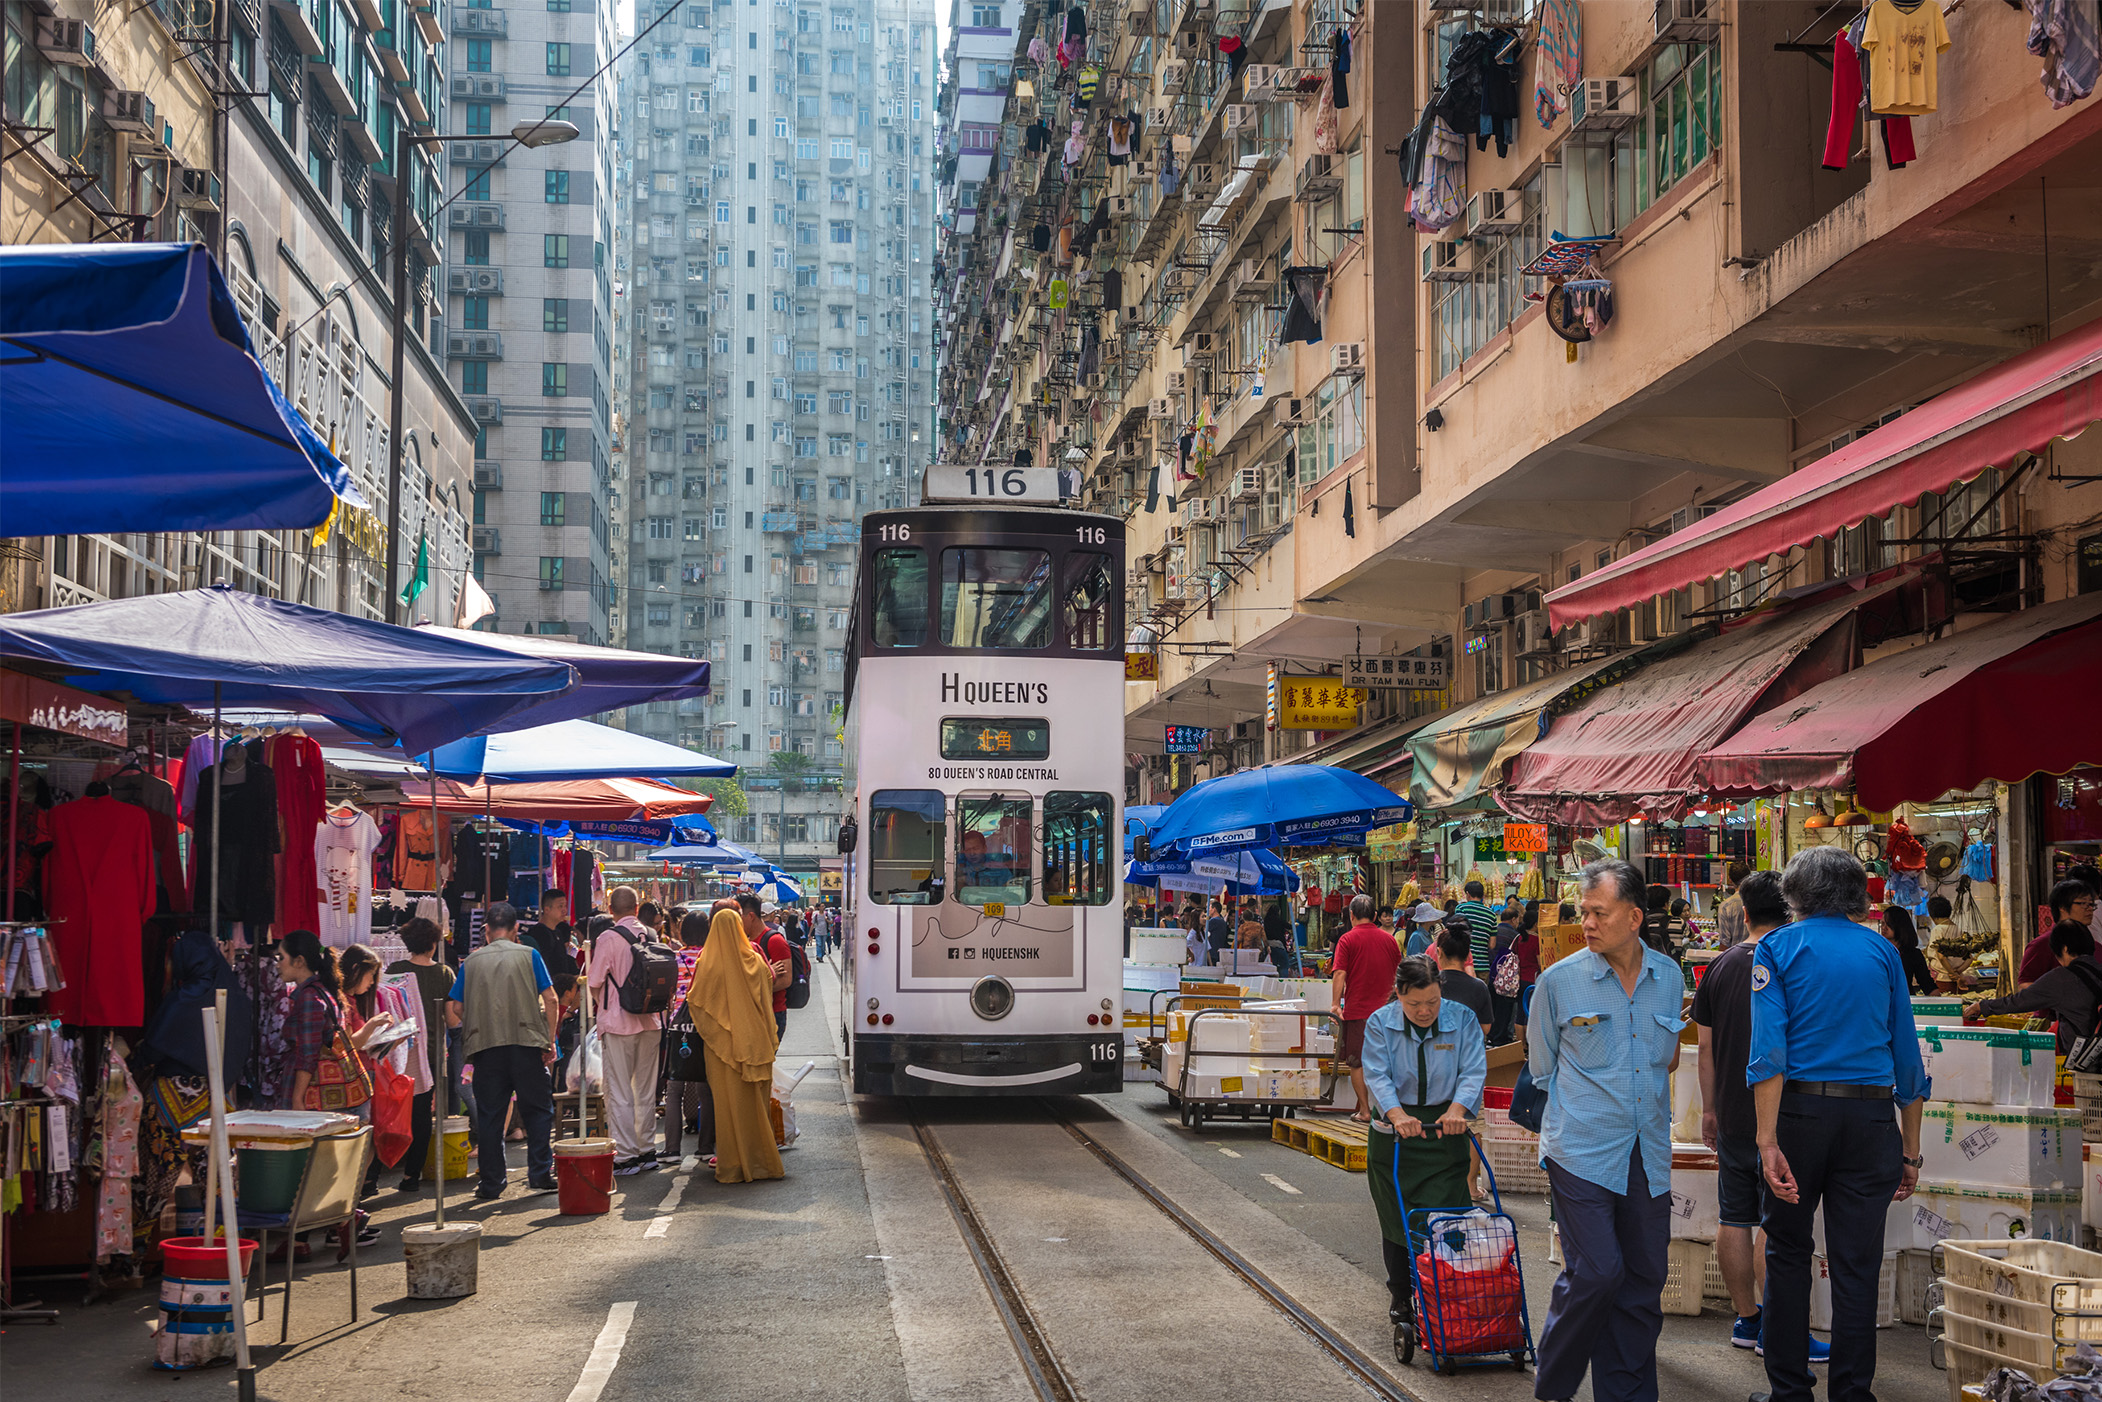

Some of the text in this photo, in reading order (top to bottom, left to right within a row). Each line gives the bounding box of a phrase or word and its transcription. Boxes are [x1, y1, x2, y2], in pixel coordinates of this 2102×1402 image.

[965, 468, 1027, 496] 116
[879, 523, 910, 541] 116
[1076, 526, 1106, 544] 116
[941, 672, 1048, 705] H QUEEN'S
[1352, 676, 1440, 687] DR TAM WAI FUN
[977, 729, 1012, 752] 北角
[928, 767, 941, 779] 80
[987, 768, 1014, 780] ROAD
[1016, 768, 1059, 780] CENTRAL
[1320, 818, 1340, 828] 6930
[1340, 814, 1361, 825] 3940
[617, 824, 638, 833] 6930
[639, 826, 661, 837] 3940
[1505, 828, 1532, 839] TULOY
[1192, 833, 1245, 846] BFMe.com
[1509, 839, 1543, 849] KAYO
[986, 904, 1002, 916] 109
[982, 947, 1040, 961] HQUEENSHK
[1090, 1043, 1116, 1061] 116
